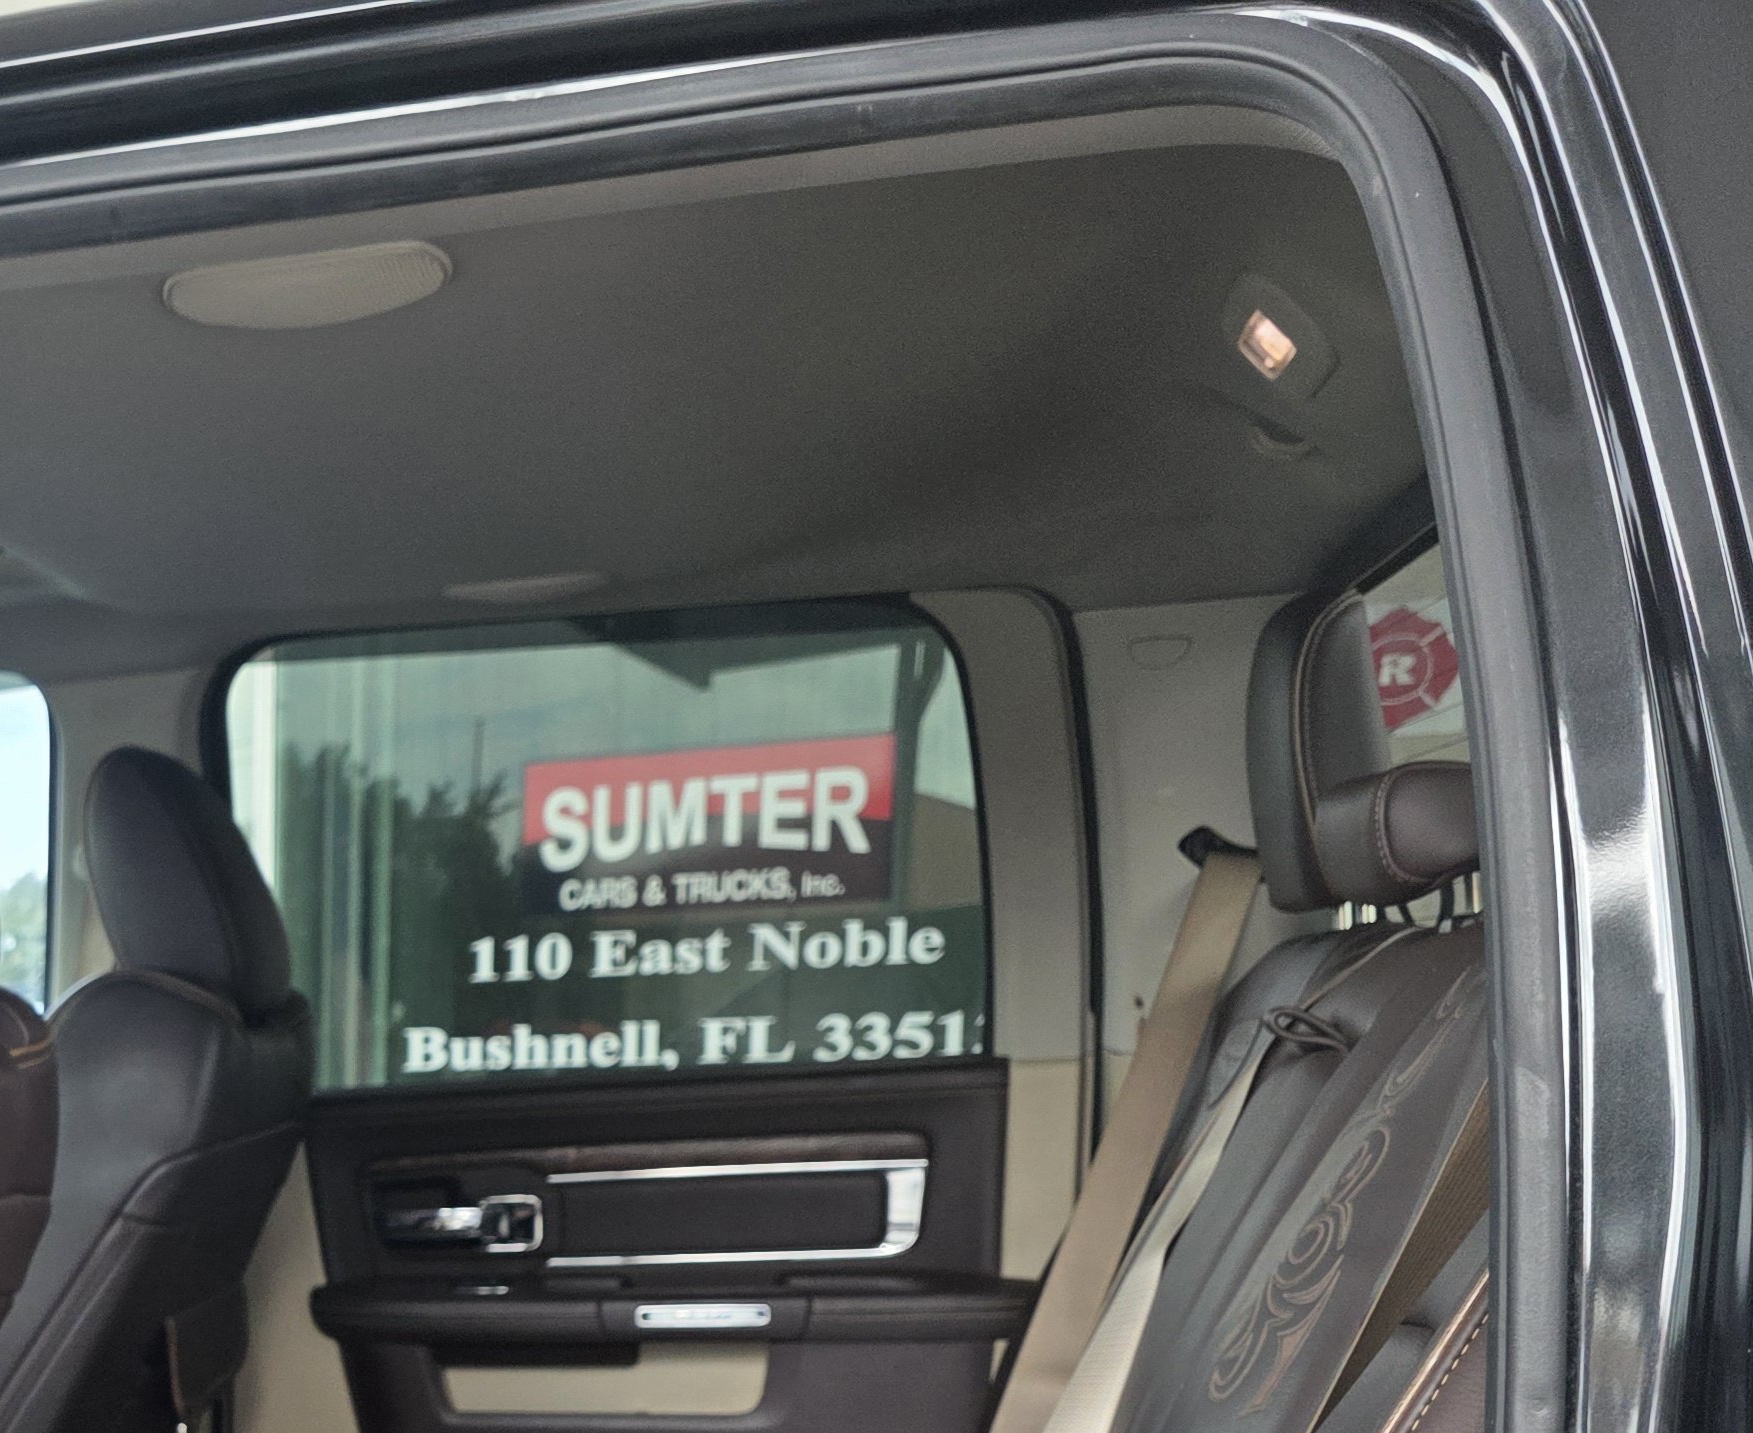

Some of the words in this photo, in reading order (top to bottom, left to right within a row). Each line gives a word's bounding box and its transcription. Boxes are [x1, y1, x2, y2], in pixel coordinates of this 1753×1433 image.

[540, 766, 871, 872] SUMTER
[559, 875, 638, 912] CARS
[643, 874, 667, 907] &
[671, 866, 797, 904] TRUCKS,
[467, 931, 574, 984] 110
[588, 928, 733, 979] East
[746, 915, 946, 972] Noble
[400, 1018, 680, 1074] Bushnell,
[695, 1014, 797, 1065] FL
